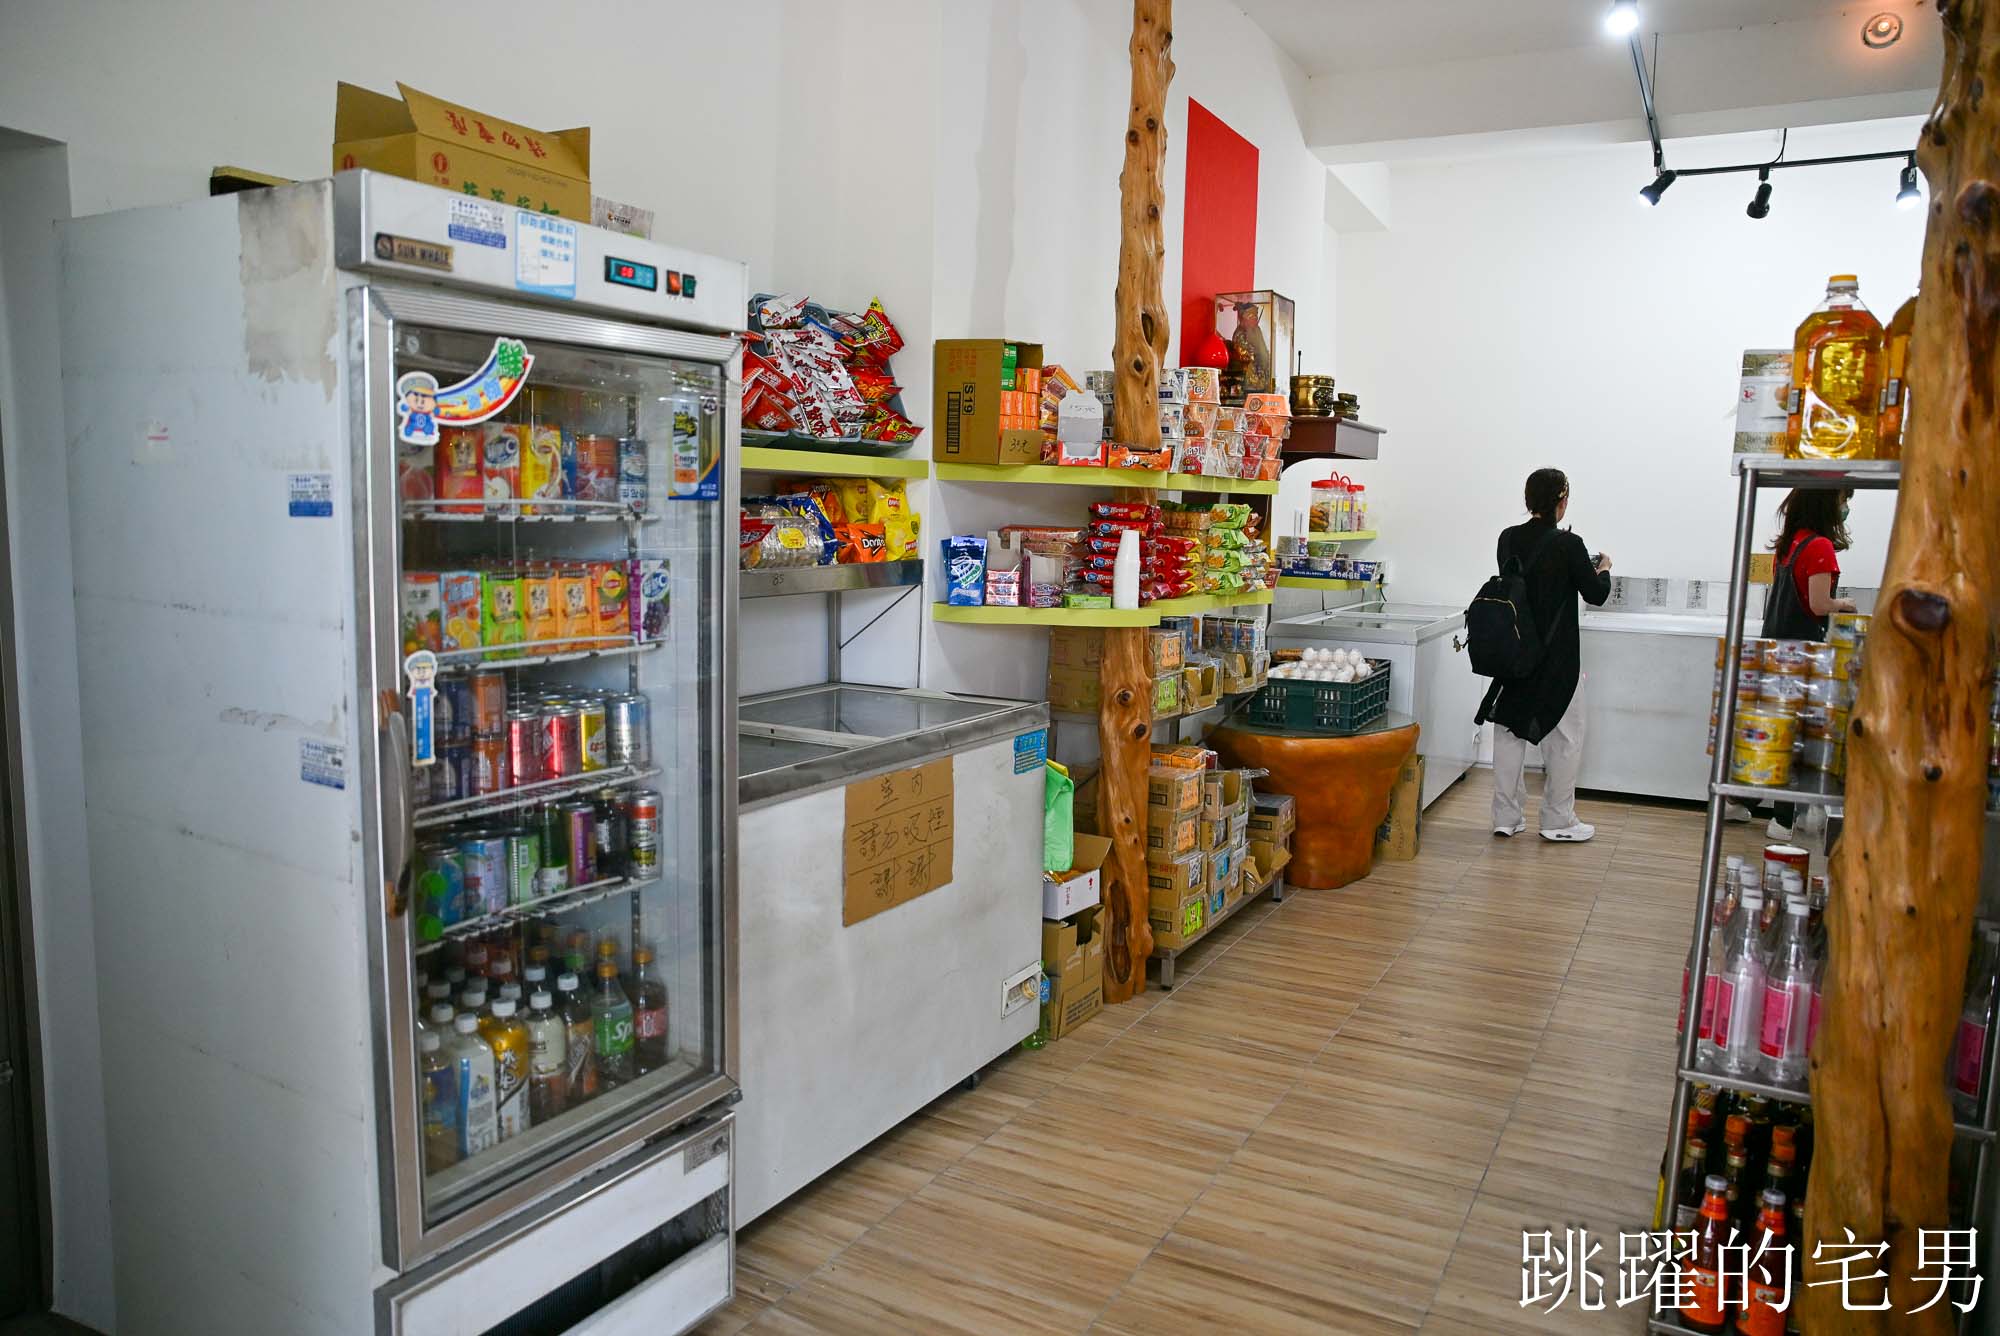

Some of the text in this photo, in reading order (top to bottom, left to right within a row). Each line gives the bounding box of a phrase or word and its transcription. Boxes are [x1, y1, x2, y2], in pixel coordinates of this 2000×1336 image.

[964, 384, 974, 413] S19
[875, 772, 923, 811] 室內
[870, 844, 937, 903] 謝謝
